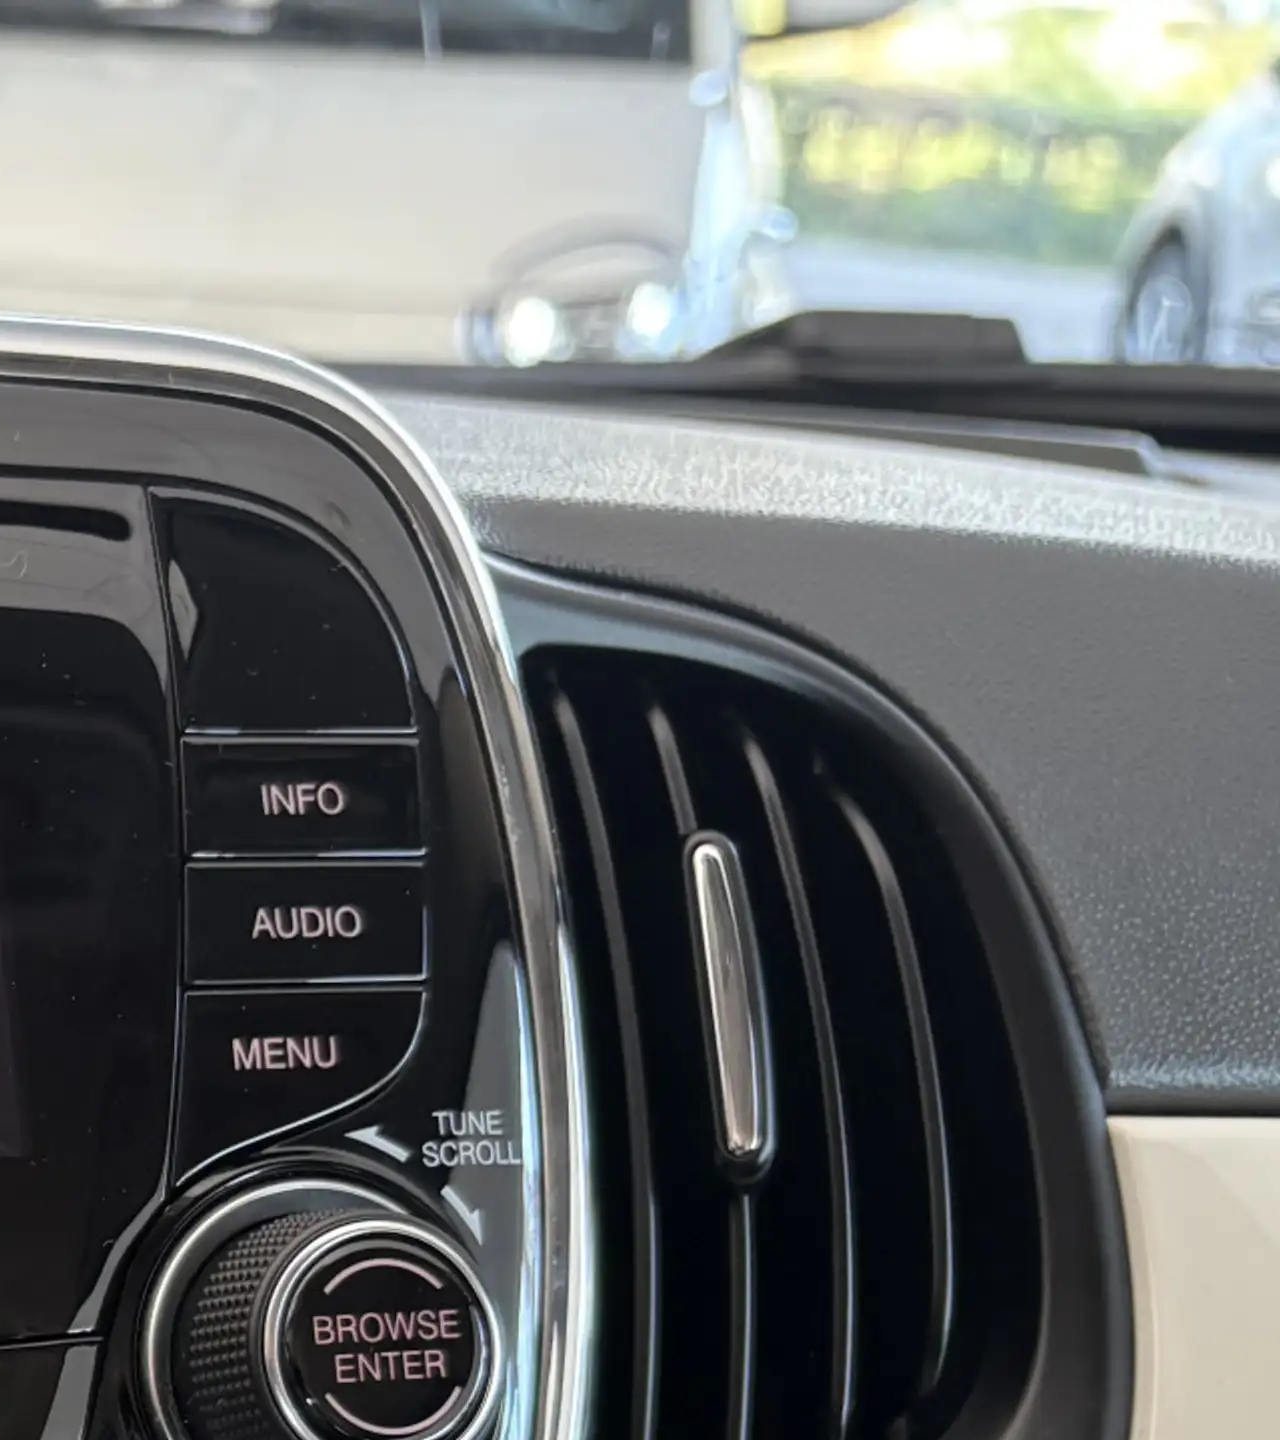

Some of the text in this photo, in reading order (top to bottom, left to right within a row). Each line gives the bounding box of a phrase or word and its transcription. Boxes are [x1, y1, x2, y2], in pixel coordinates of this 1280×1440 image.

[261, 782, 344, 815] INFO
[252, 905, 362, 939] AUDIO
[232, 1036, 337, 1071] MENU
[431, 1108, 504, 1137] TUNE
[422, 1139, 521, 1167] SCROLL
[312, 1309, 461, 1345] BROWSE
[334, 1349, 446, 1383] ENTER
